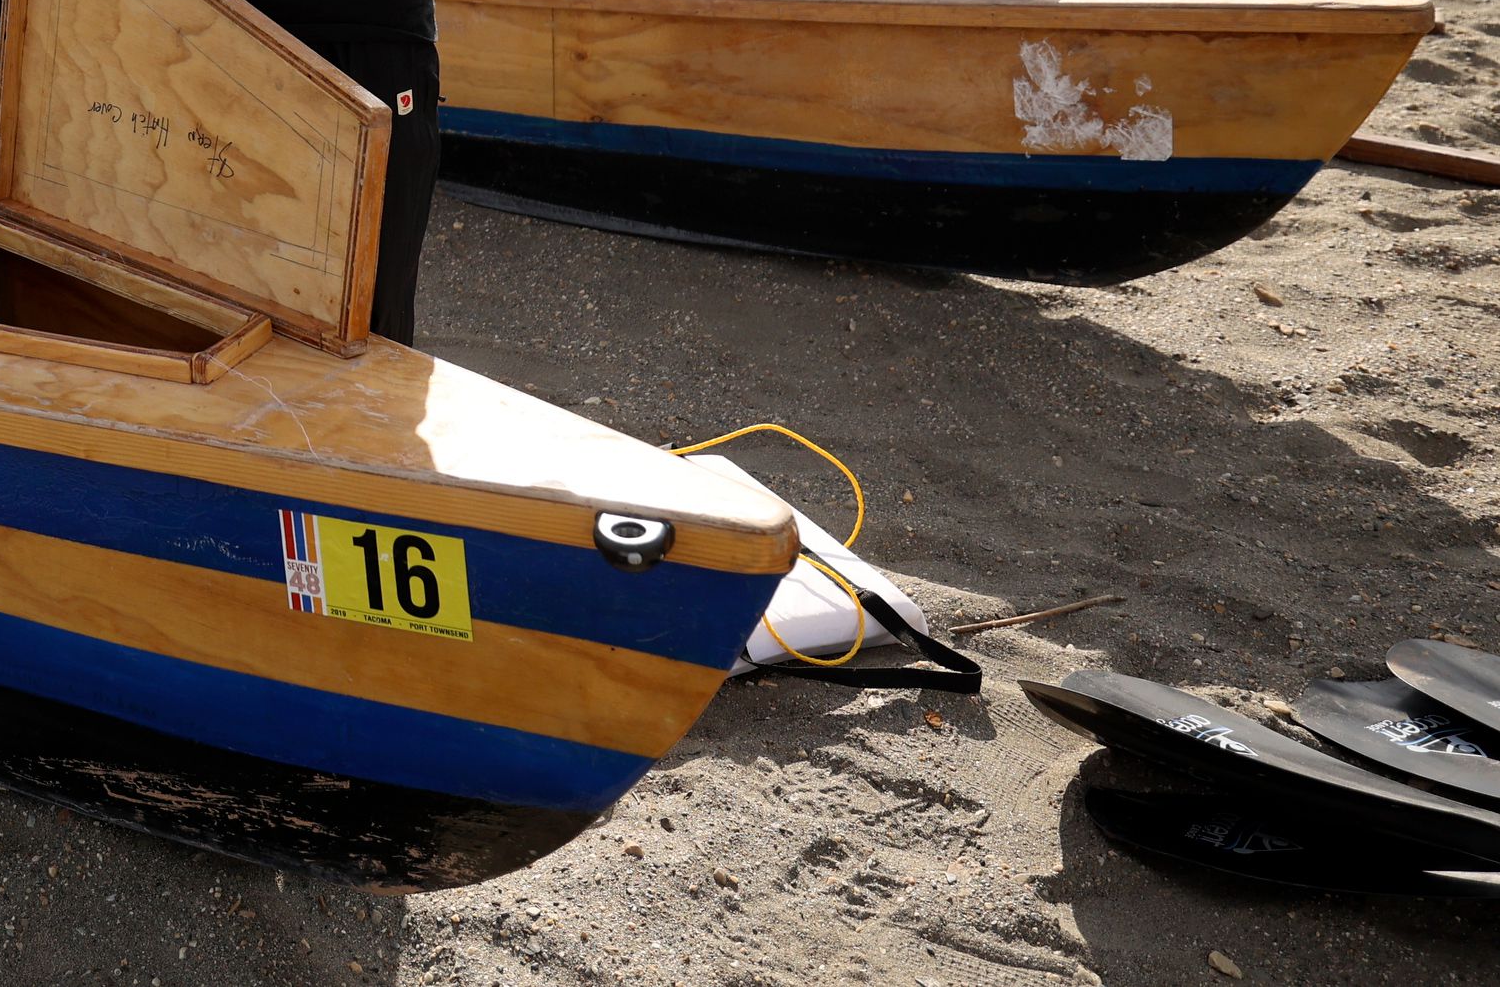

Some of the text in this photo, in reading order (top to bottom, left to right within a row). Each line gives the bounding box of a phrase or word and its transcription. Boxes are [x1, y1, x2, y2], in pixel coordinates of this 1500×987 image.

[88, 101, 123, 123] Cover
[286, 560, 319, 575] SEVENTY
[352, 528, 441, 619] 16
[289, 571, 321, 595] 48
[330, 608, 469, 639] 2019 TACOMA PORT TOWNSEND
